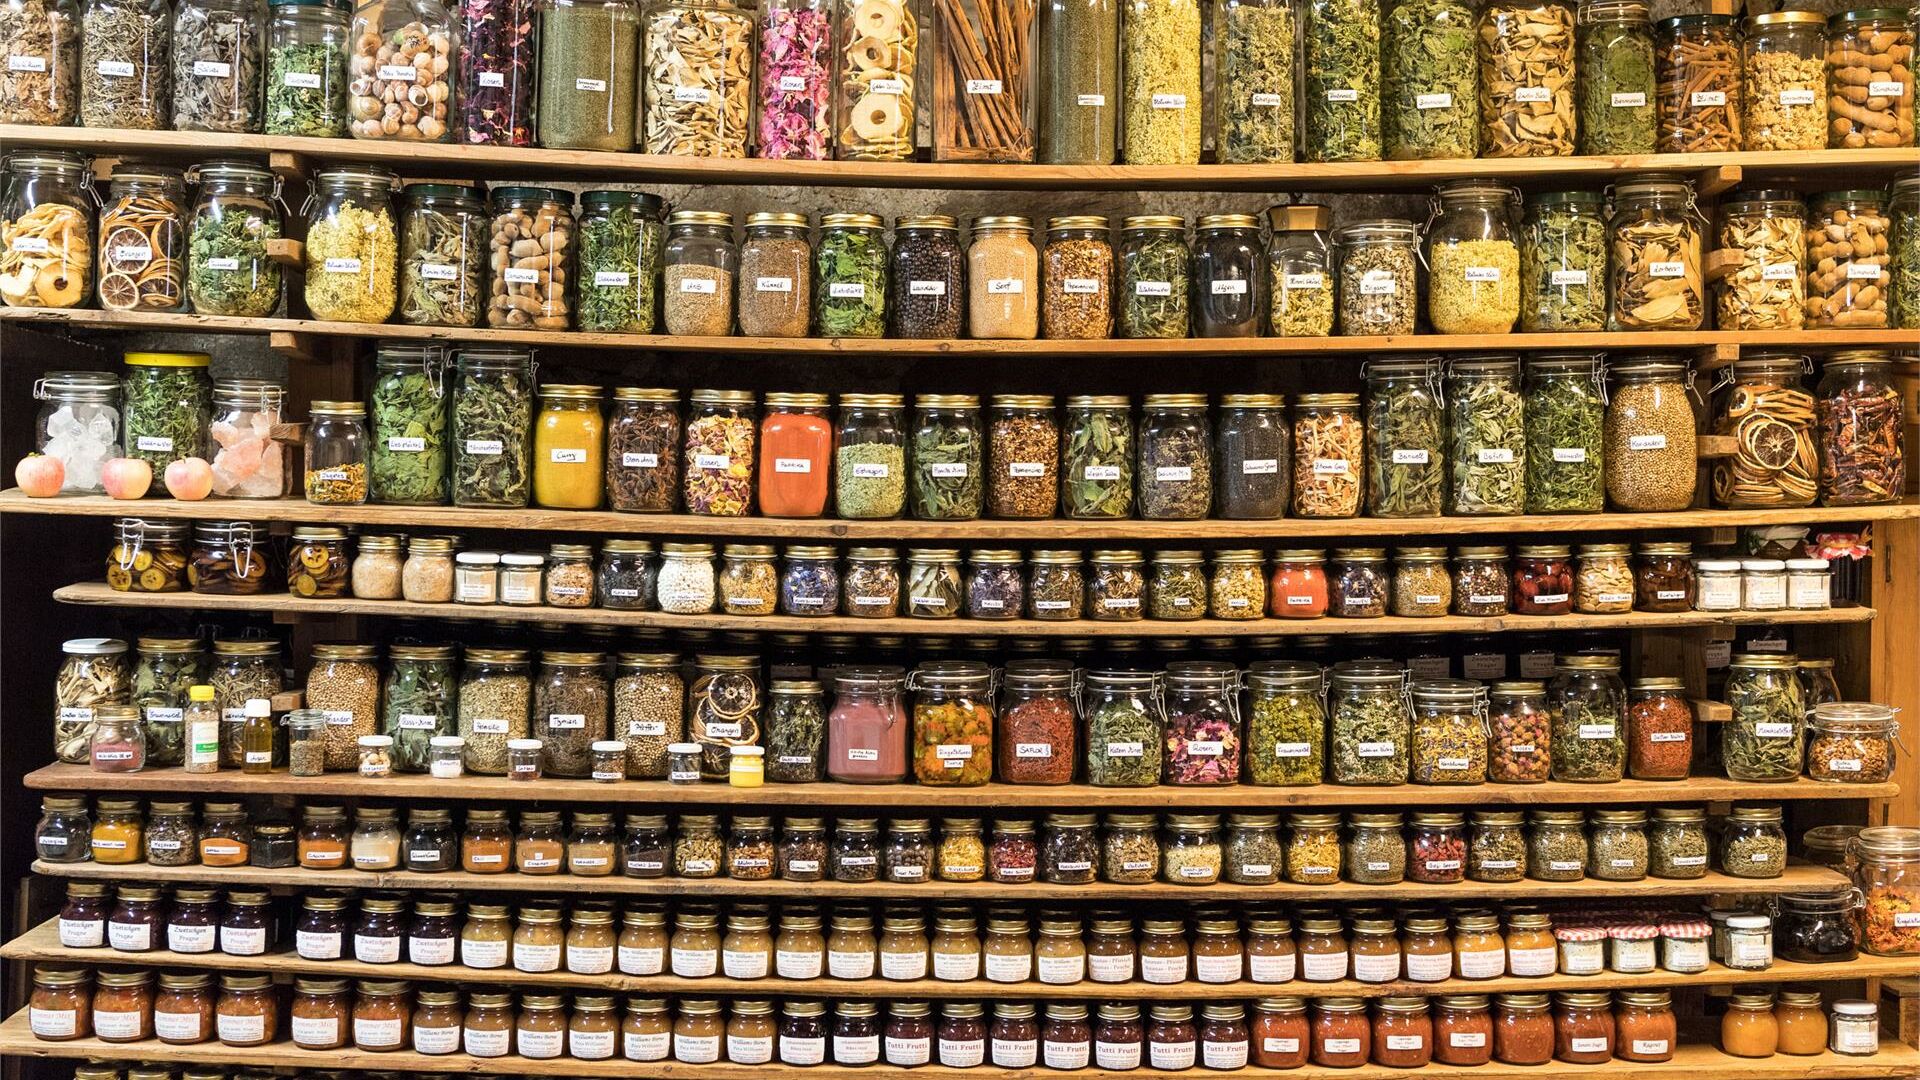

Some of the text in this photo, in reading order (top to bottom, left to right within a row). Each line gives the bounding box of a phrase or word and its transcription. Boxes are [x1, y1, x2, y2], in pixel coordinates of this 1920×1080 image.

[972, 81, 993, 92] Zimt
[994, 281, 1011, 290] Senf
[556, 451, 578, 460] Curry
[711, 726, 739, 736] Orangen
[1192, 743, 1214, 752] Rosen
